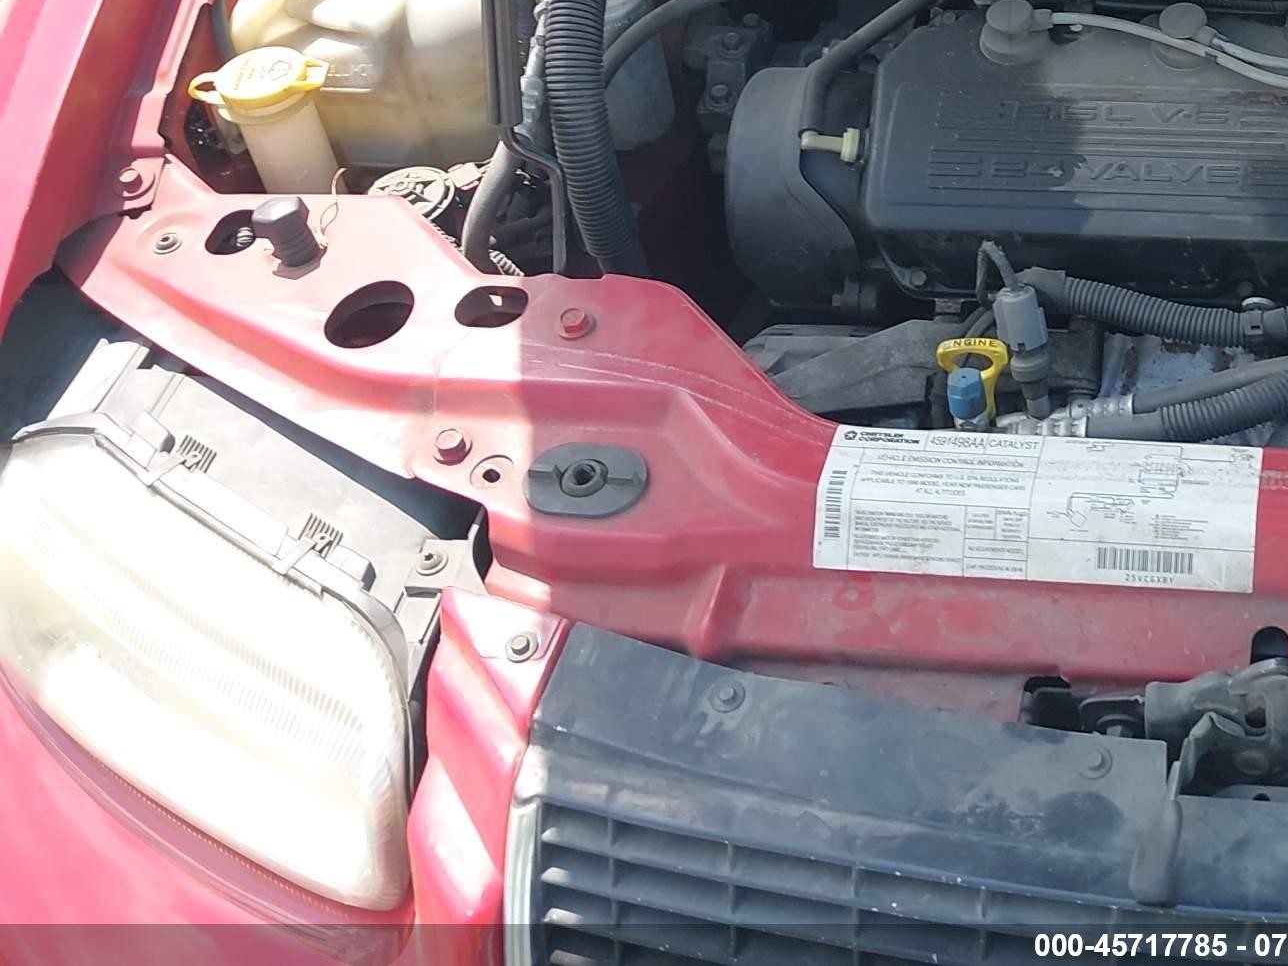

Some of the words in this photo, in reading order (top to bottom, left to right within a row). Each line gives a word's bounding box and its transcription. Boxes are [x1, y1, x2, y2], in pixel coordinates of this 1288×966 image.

[1086, 161, 1241, 185] VALVE
[952, 338, 998, 348] NGINE
[858, 436, 920, 445] CORPORATION
[988, 437, 1039, 450] CATALYST
